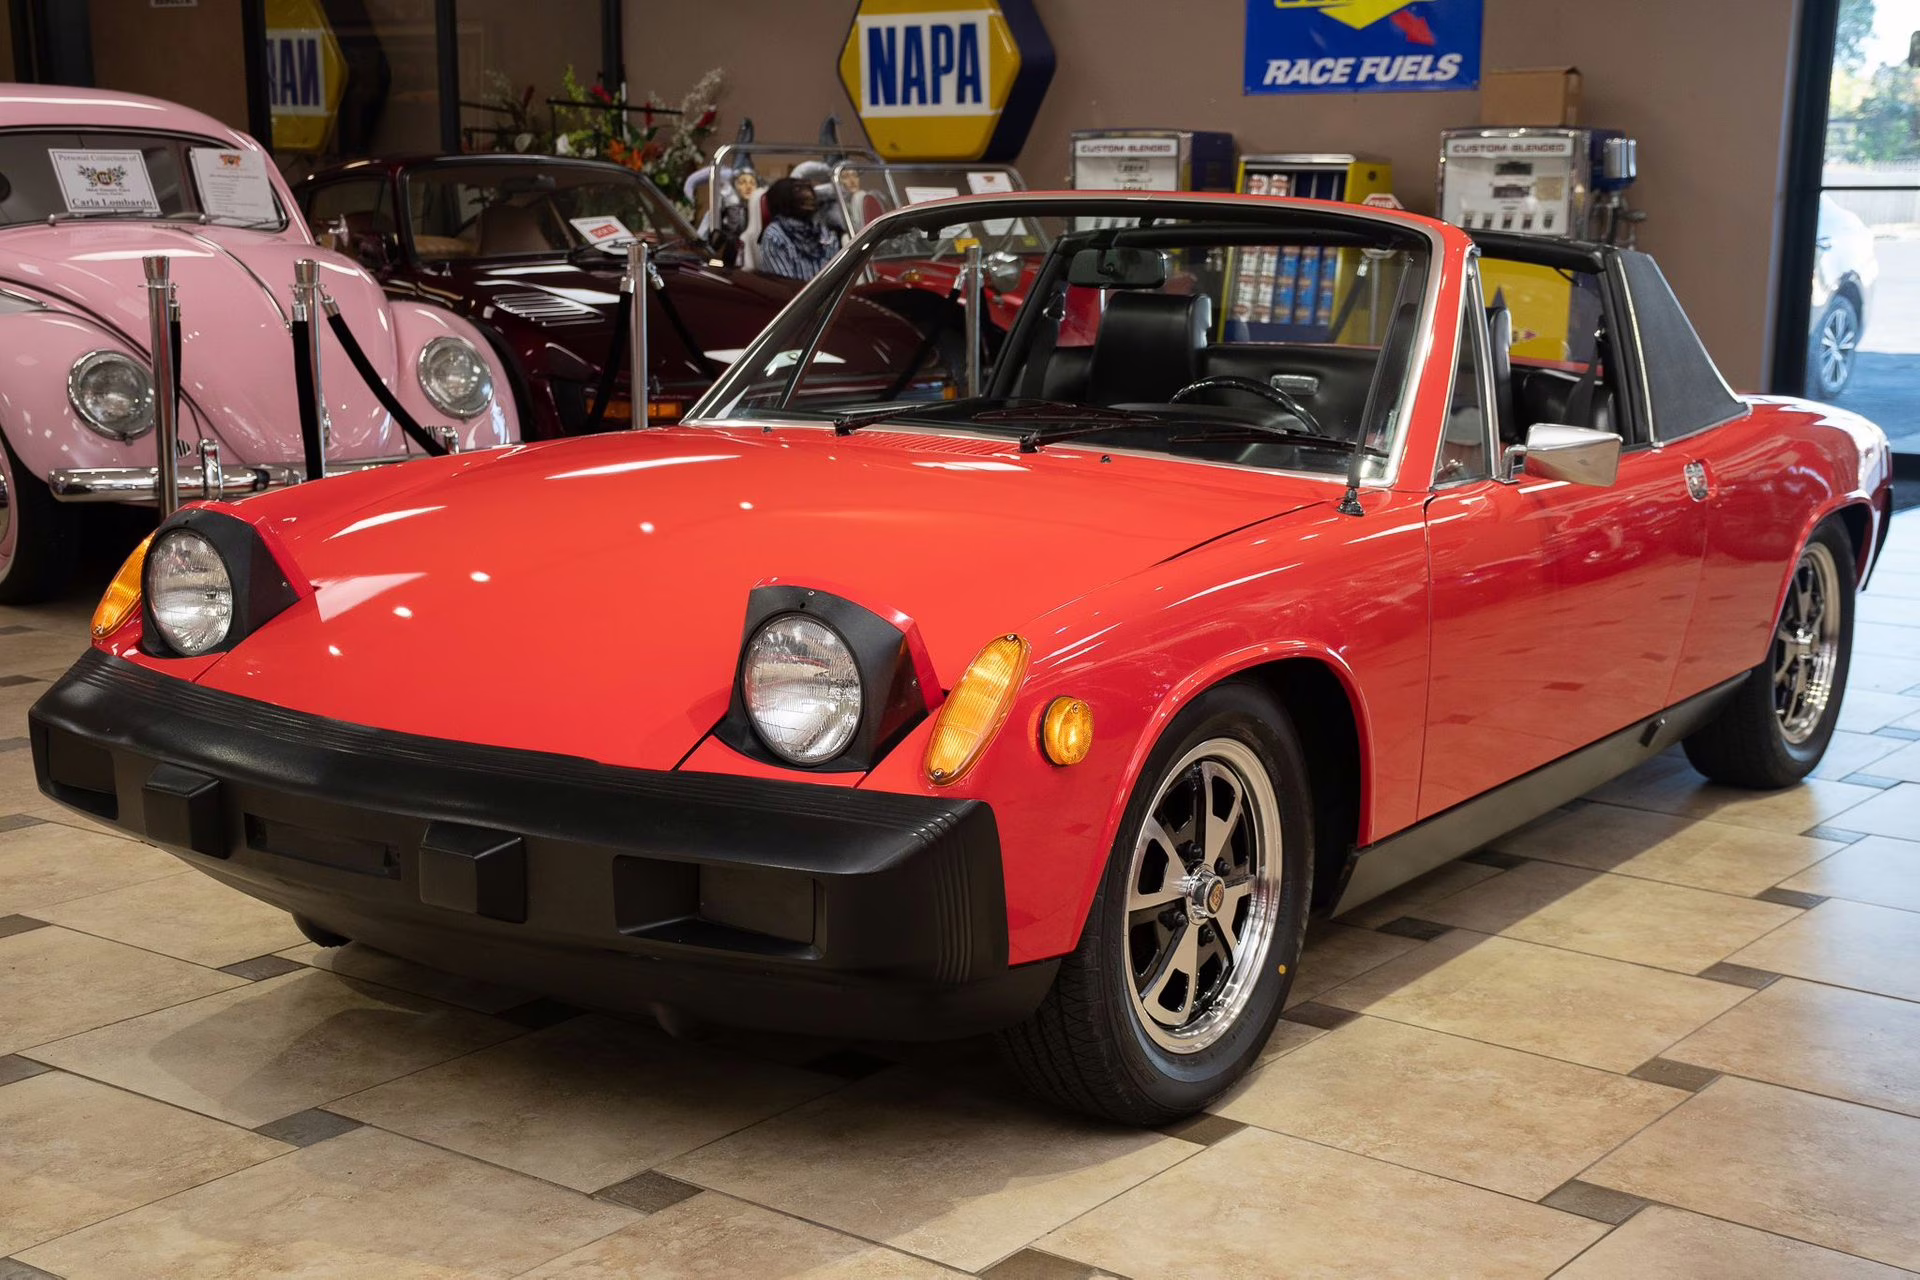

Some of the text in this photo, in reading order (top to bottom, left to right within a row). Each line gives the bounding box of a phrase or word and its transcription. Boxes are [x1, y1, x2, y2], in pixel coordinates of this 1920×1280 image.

[867, 23, 983, 106] NAPA
[1262, 53, 1463, 86] RACE FUELS
[72, 198, 153, 207] Carla Lombardo
